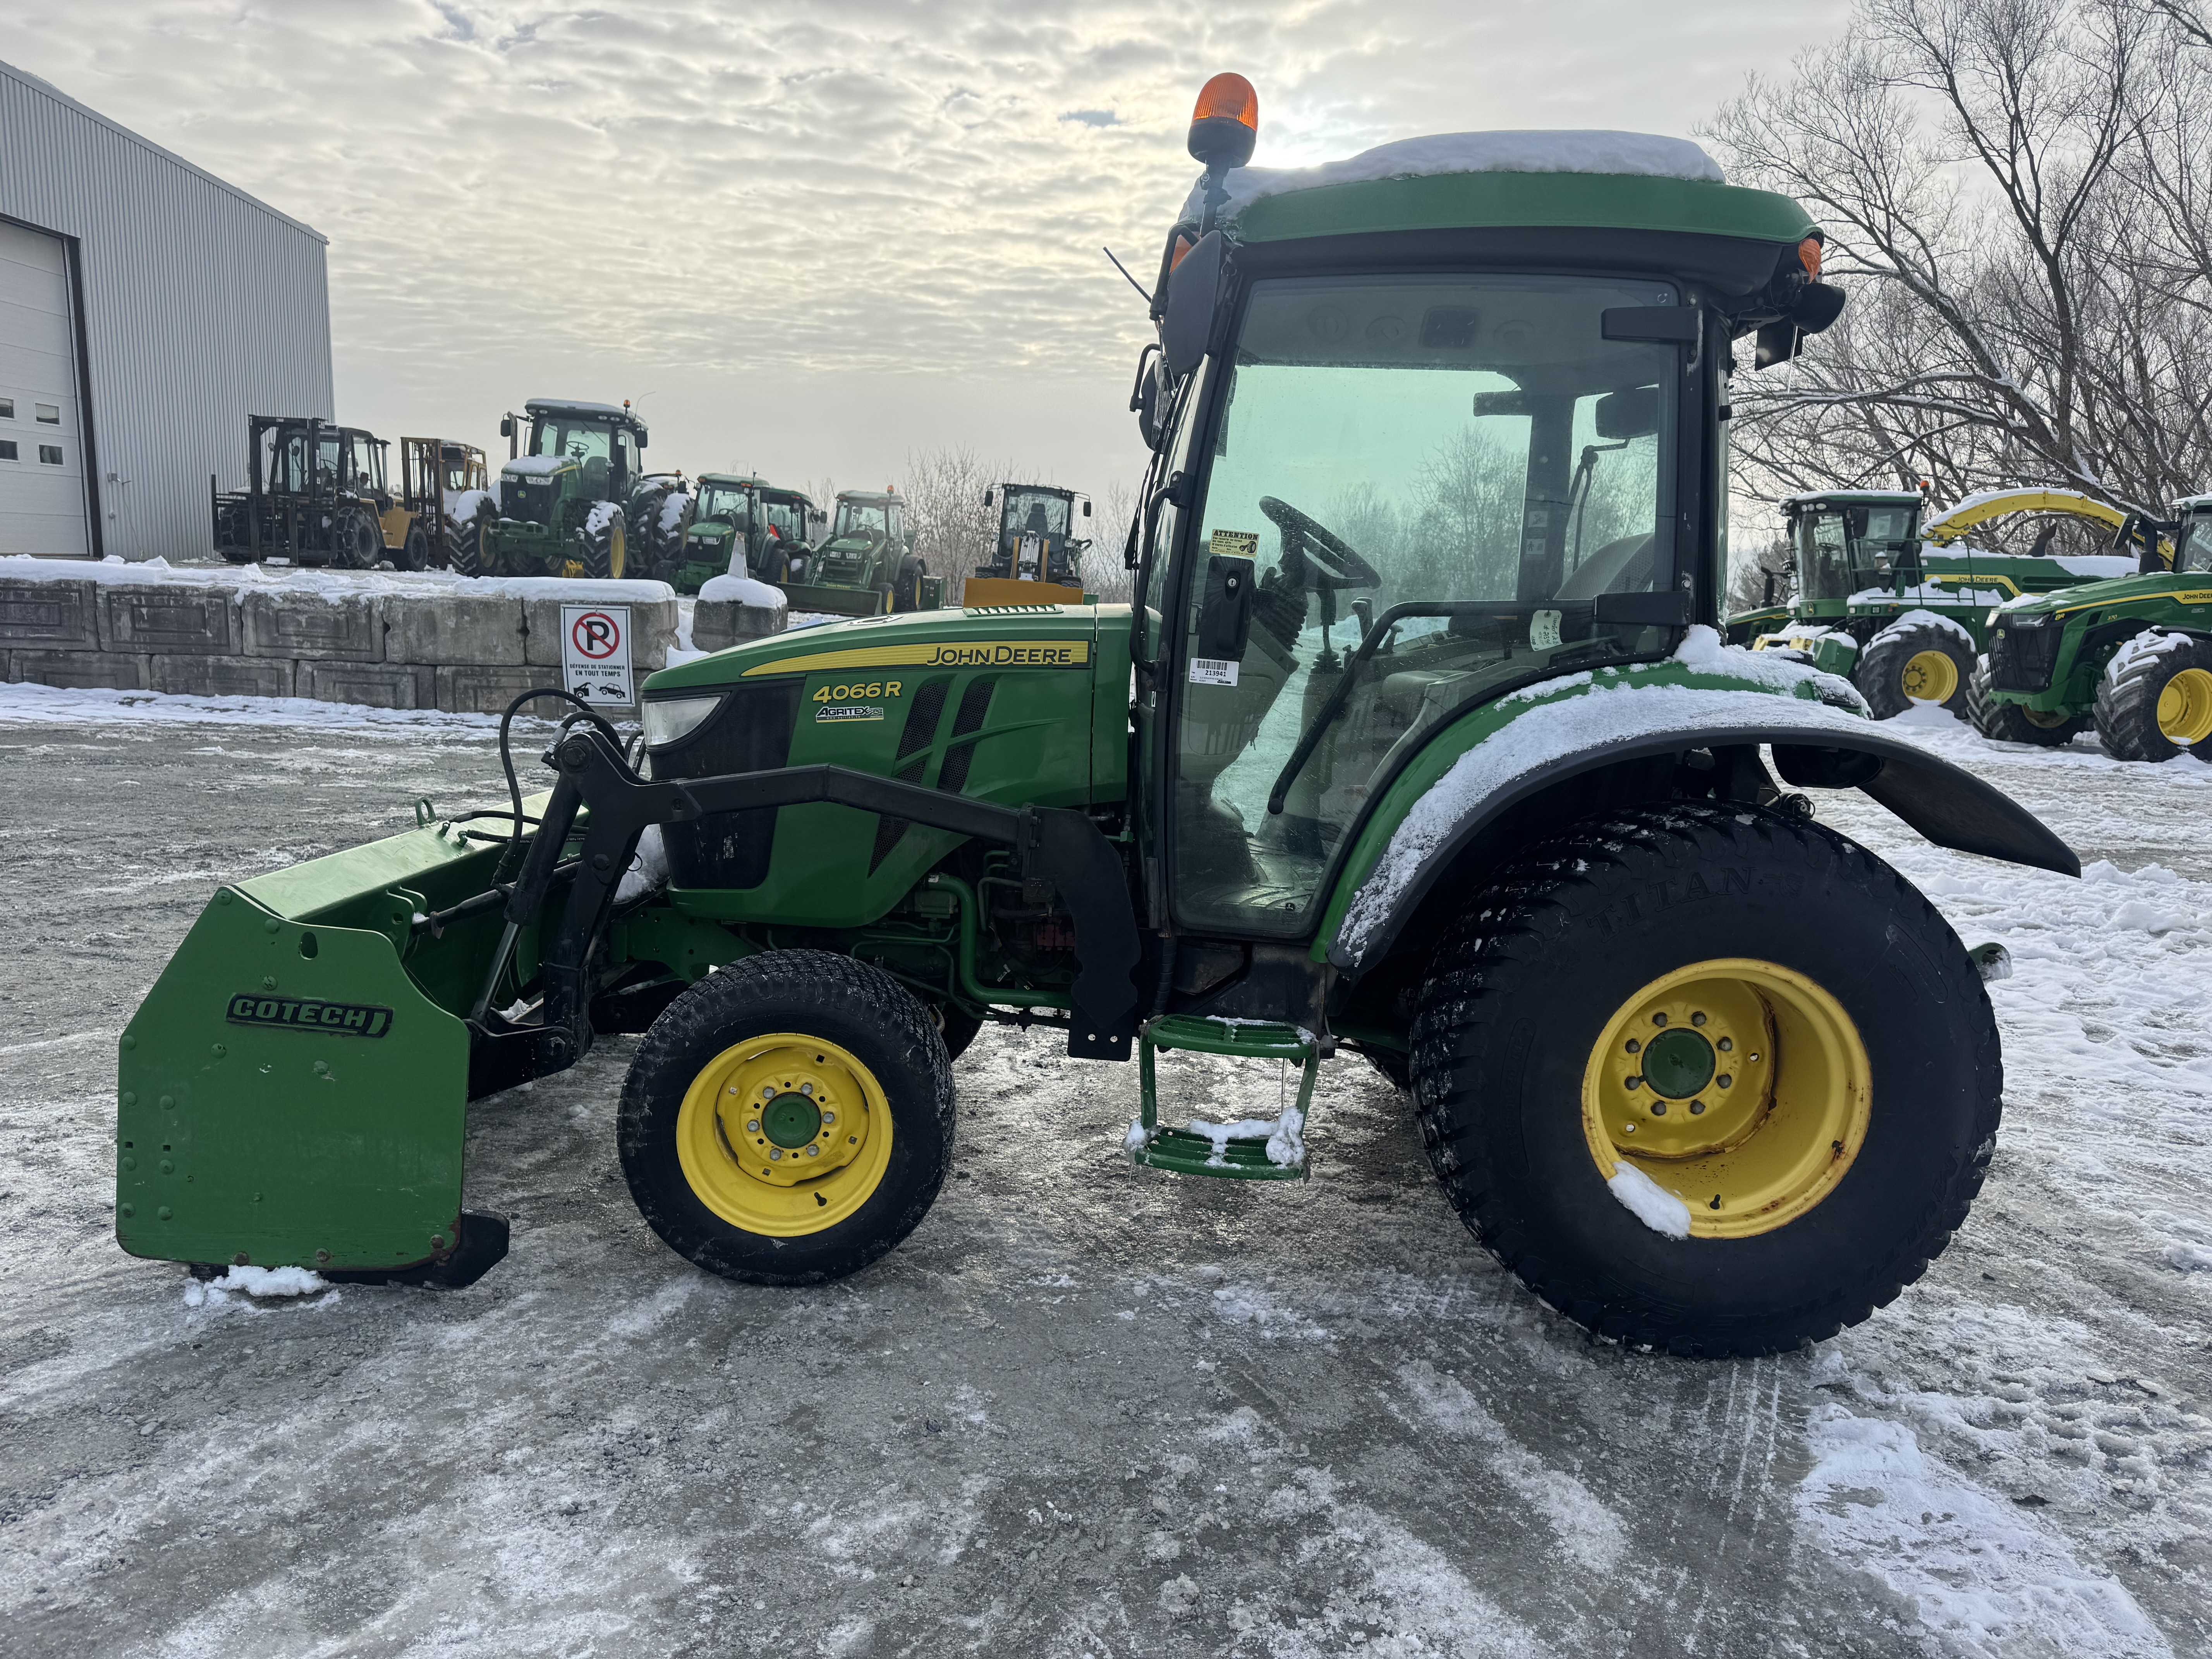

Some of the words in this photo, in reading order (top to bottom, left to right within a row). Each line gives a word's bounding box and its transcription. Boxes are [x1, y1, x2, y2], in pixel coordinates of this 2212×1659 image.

[1213, 529, 1258, 540] ATTENTION
[927, 647, 991, 664] JOHN
[995, 646, 1072, 663] DEERE
[812, 682, 882, 704] 4066
[885, 681, 902, 697] R
[817, 706, 869, 716] AGRITEX
[1585, 866, 1757, 944] TITAN
[232, 999, 367, 1027] COTECH
